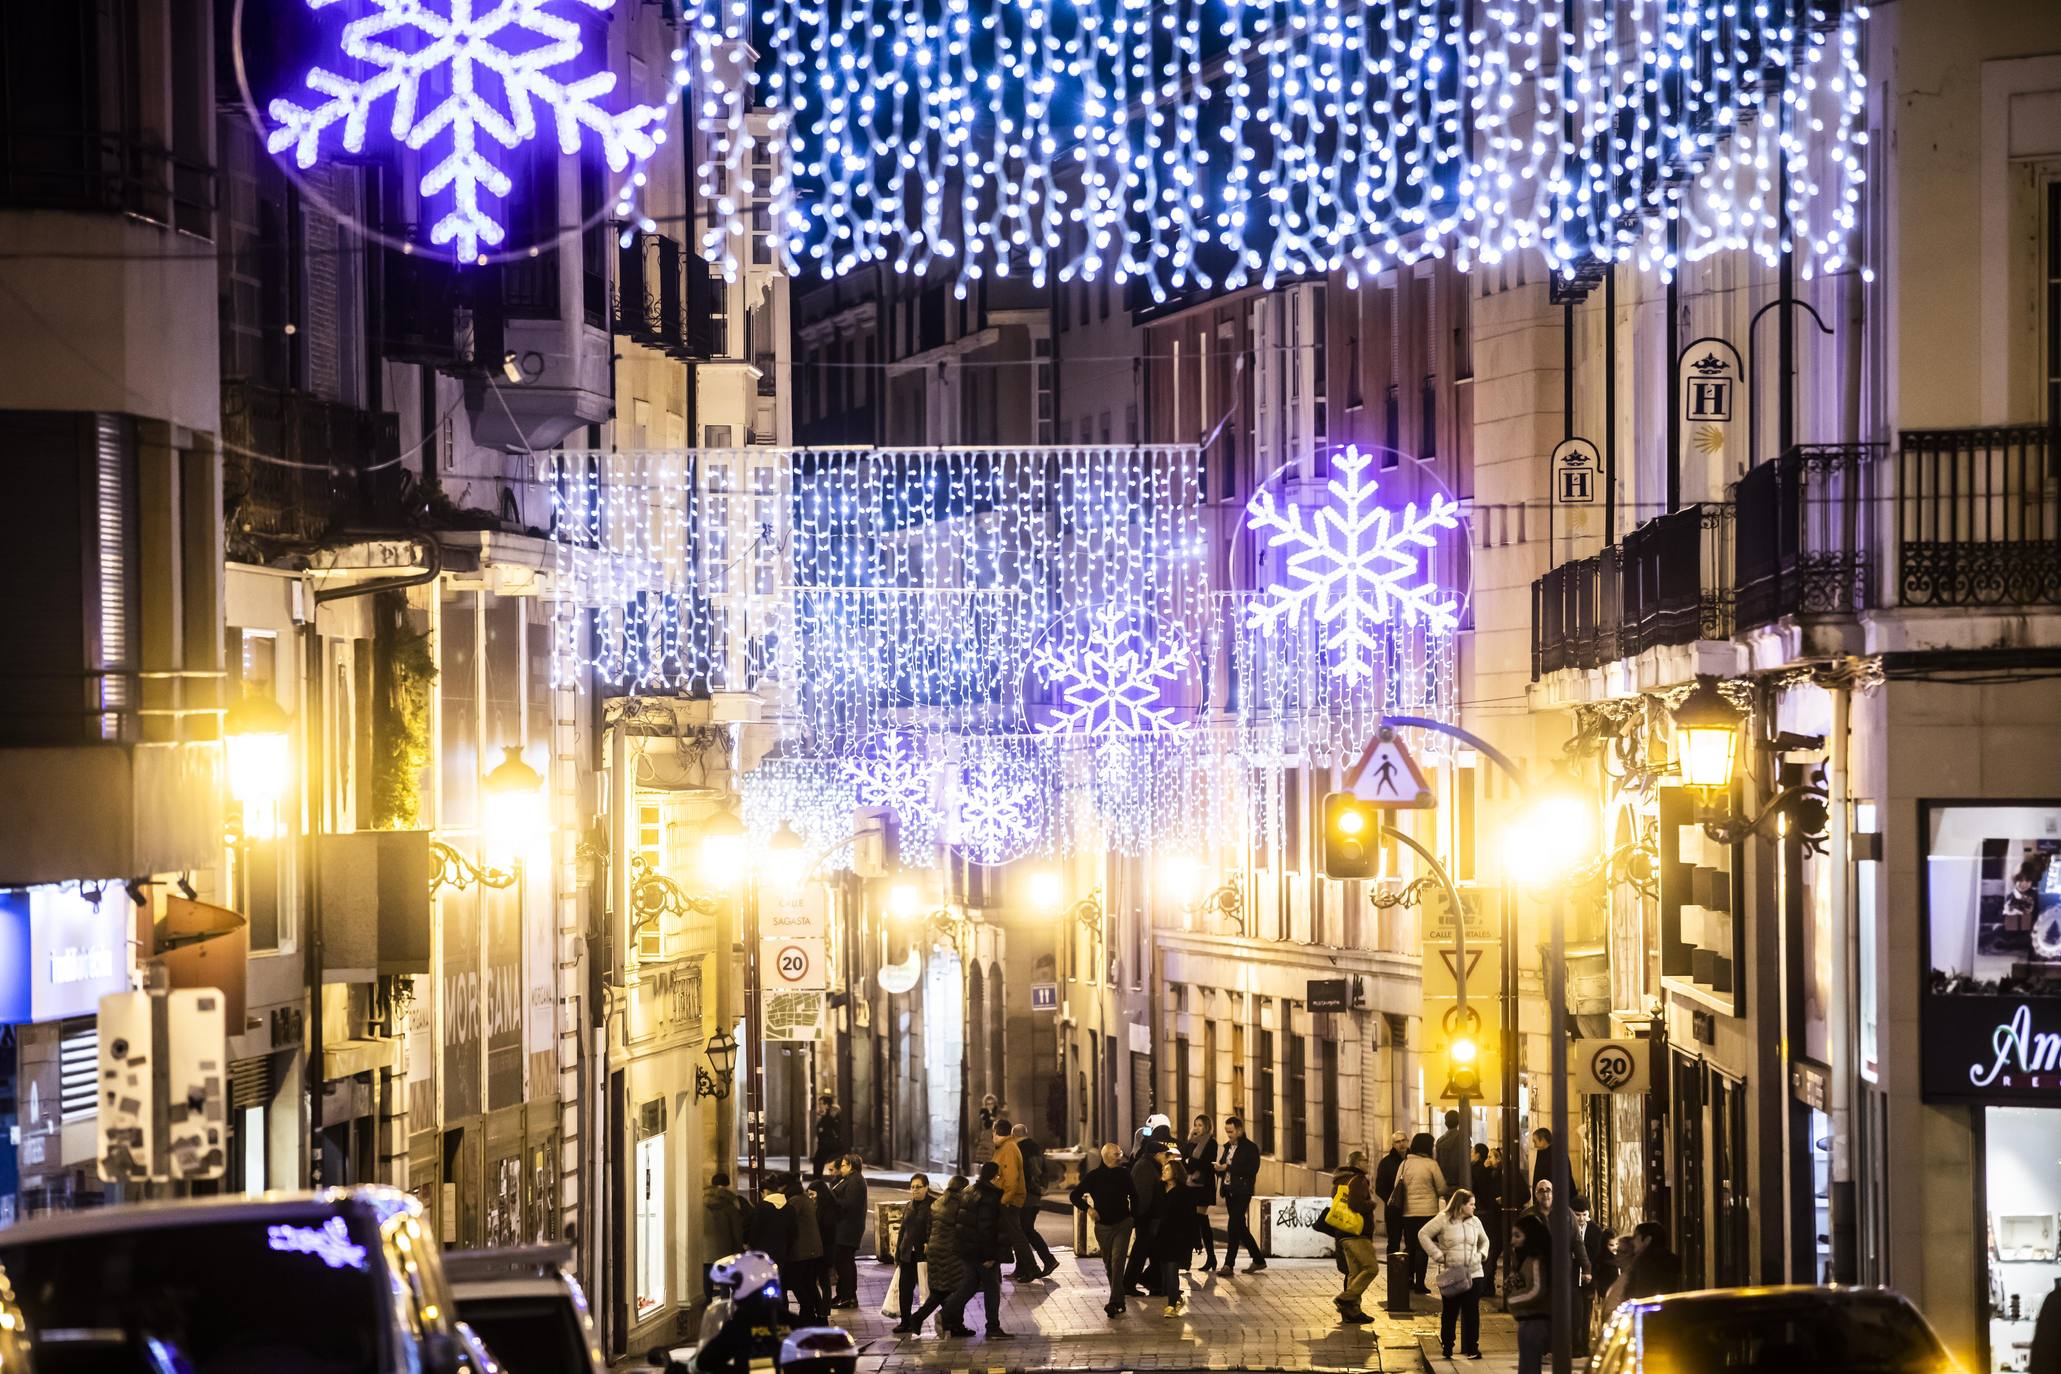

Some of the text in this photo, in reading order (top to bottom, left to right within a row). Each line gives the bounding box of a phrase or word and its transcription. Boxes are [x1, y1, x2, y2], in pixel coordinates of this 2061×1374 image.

[1693, 383, 1727, 415] H
[1564, 472, 1589, 498] H
[772, 916, 811, 926] SAGASTA
[1430, 931, 1451, 939] CALLE
[782, 956, 803, 971] 20
[444, 962, 521, 1047] MORGANA
[1600, 1057, 1627, 1076] 20
